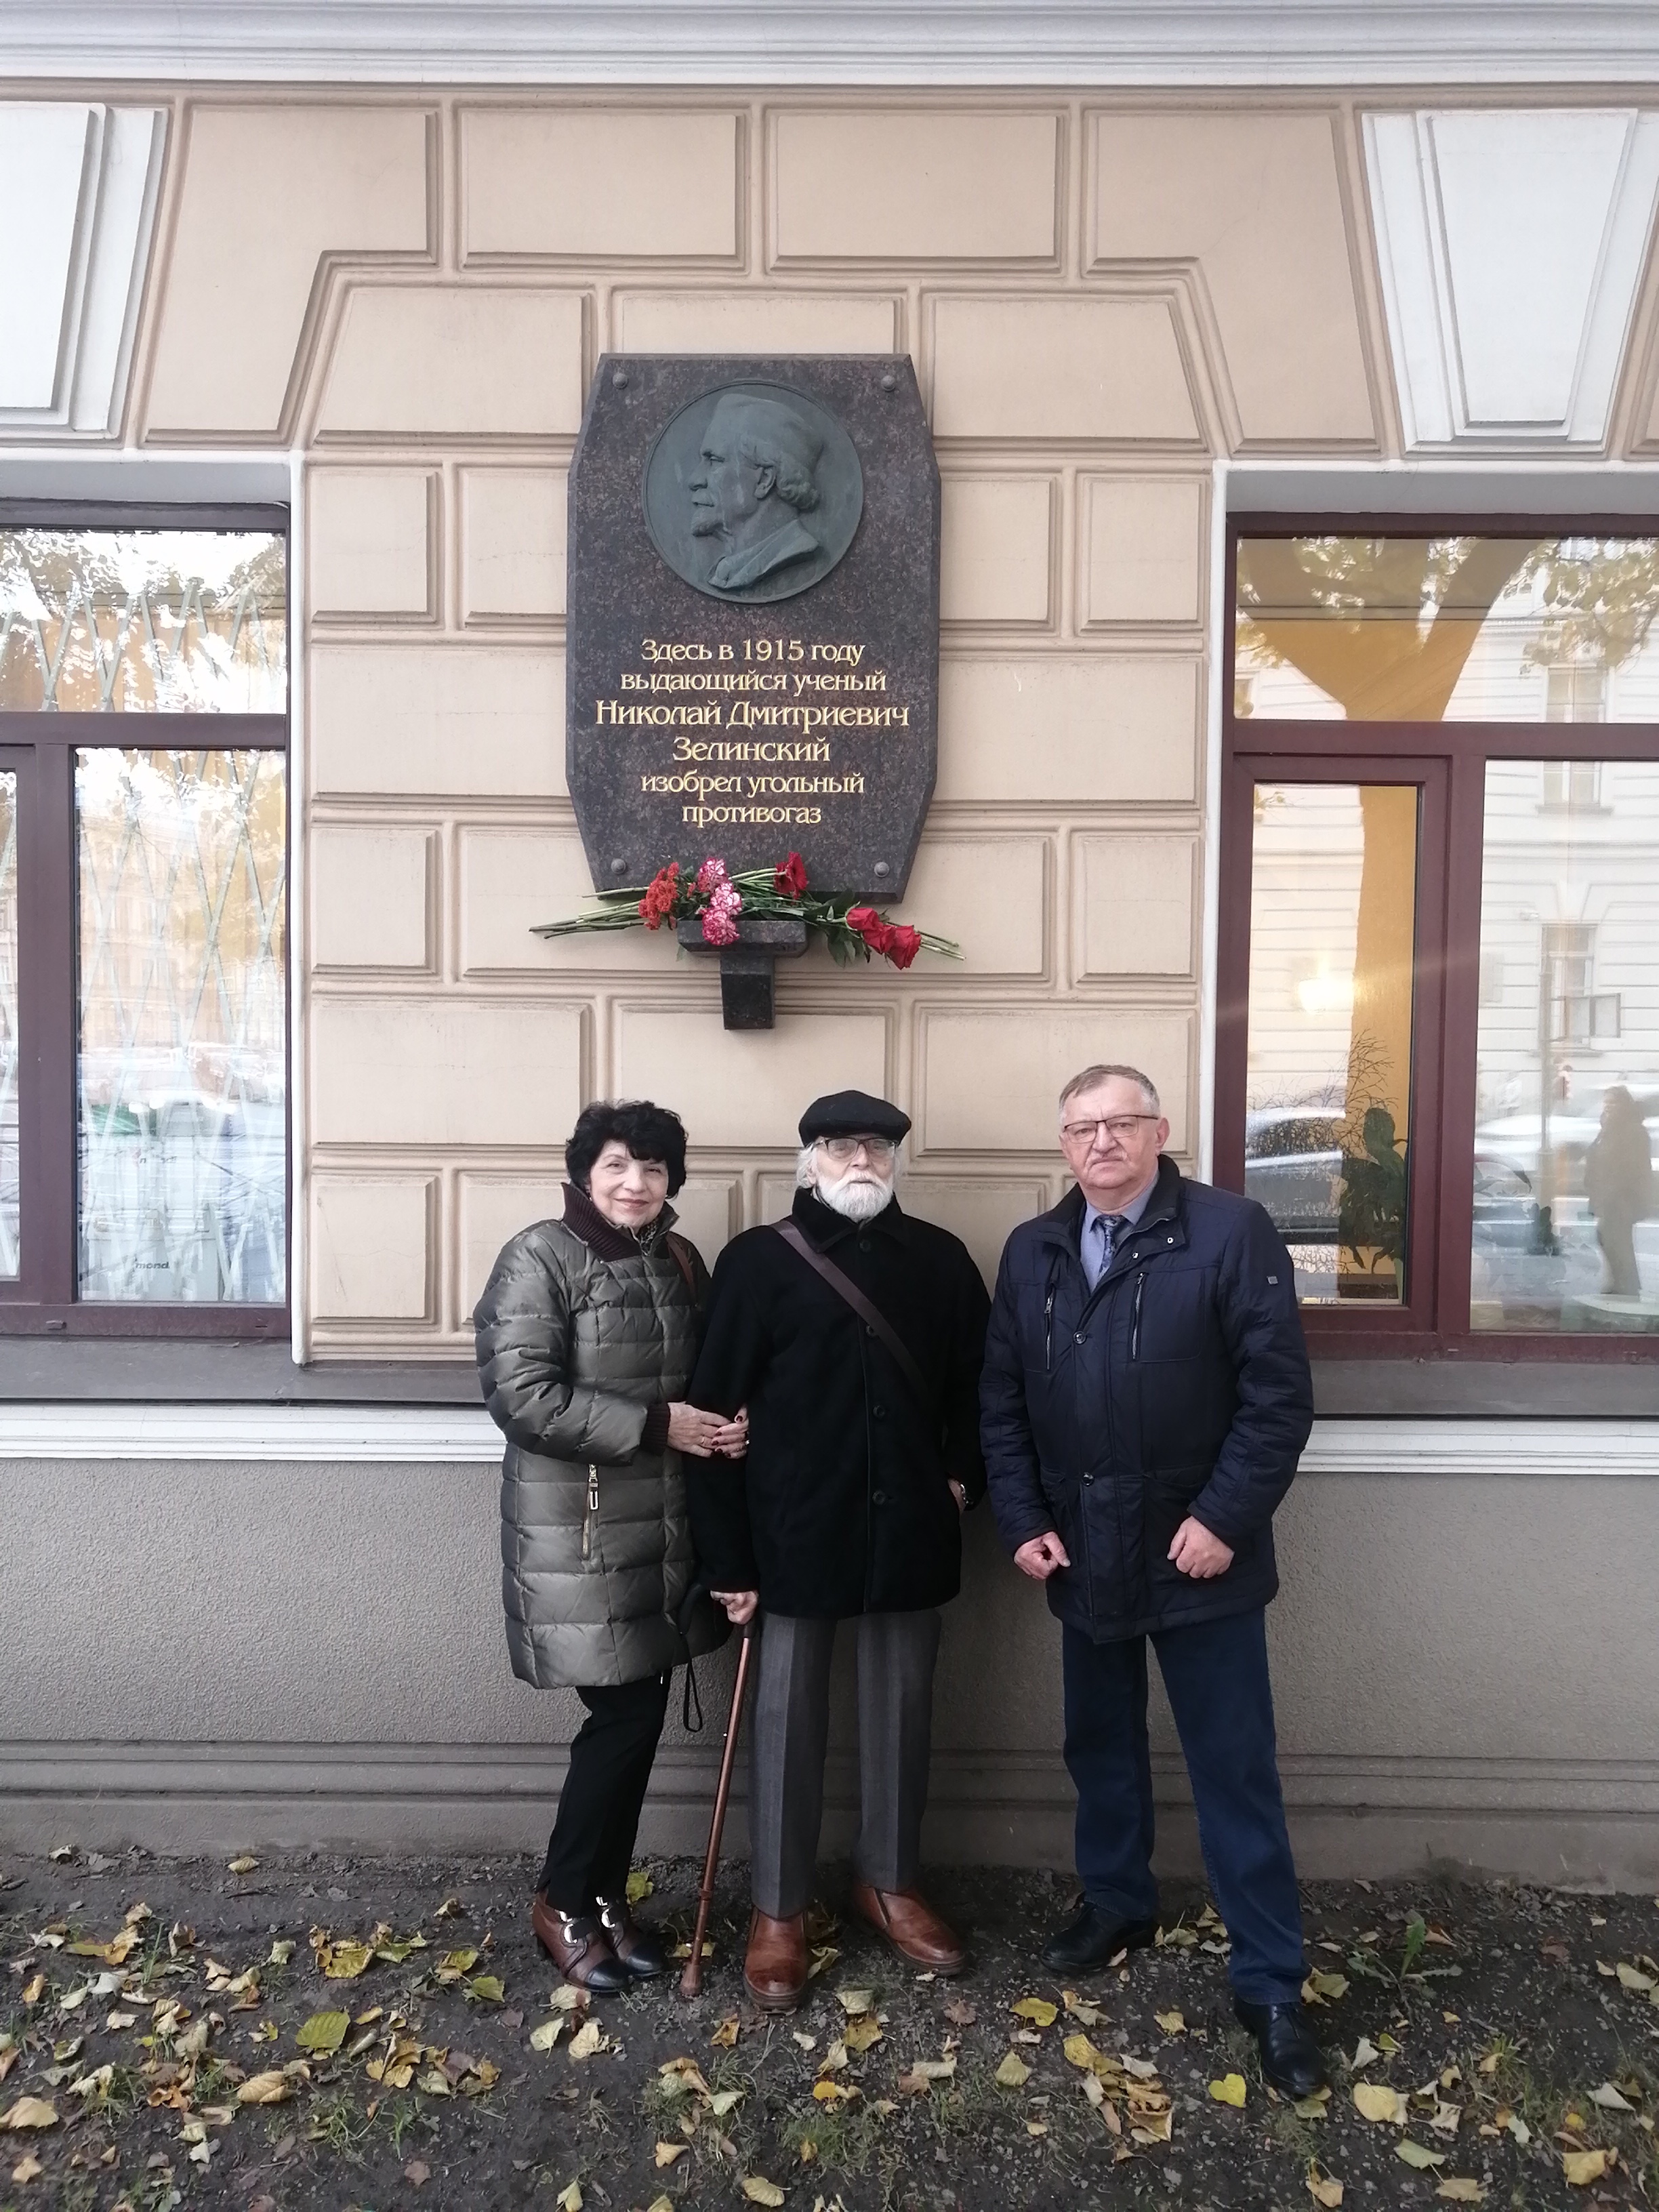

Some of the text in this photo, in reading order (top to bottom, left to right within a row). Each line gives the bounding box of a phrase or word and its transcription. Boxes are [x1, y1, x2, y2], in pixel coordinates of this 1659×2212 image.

[641, 638, 865, 666] Здесь в 1915 году
[621, 670, 886, 697] выдающийся ученый
[596, 700, 910, 734] Николай Дмитриевич
[672, 737, 831, 762] Зелинский
[640, 770, 865, 800] изобрел угольный
[682, 806, 822, 828] противогаз
